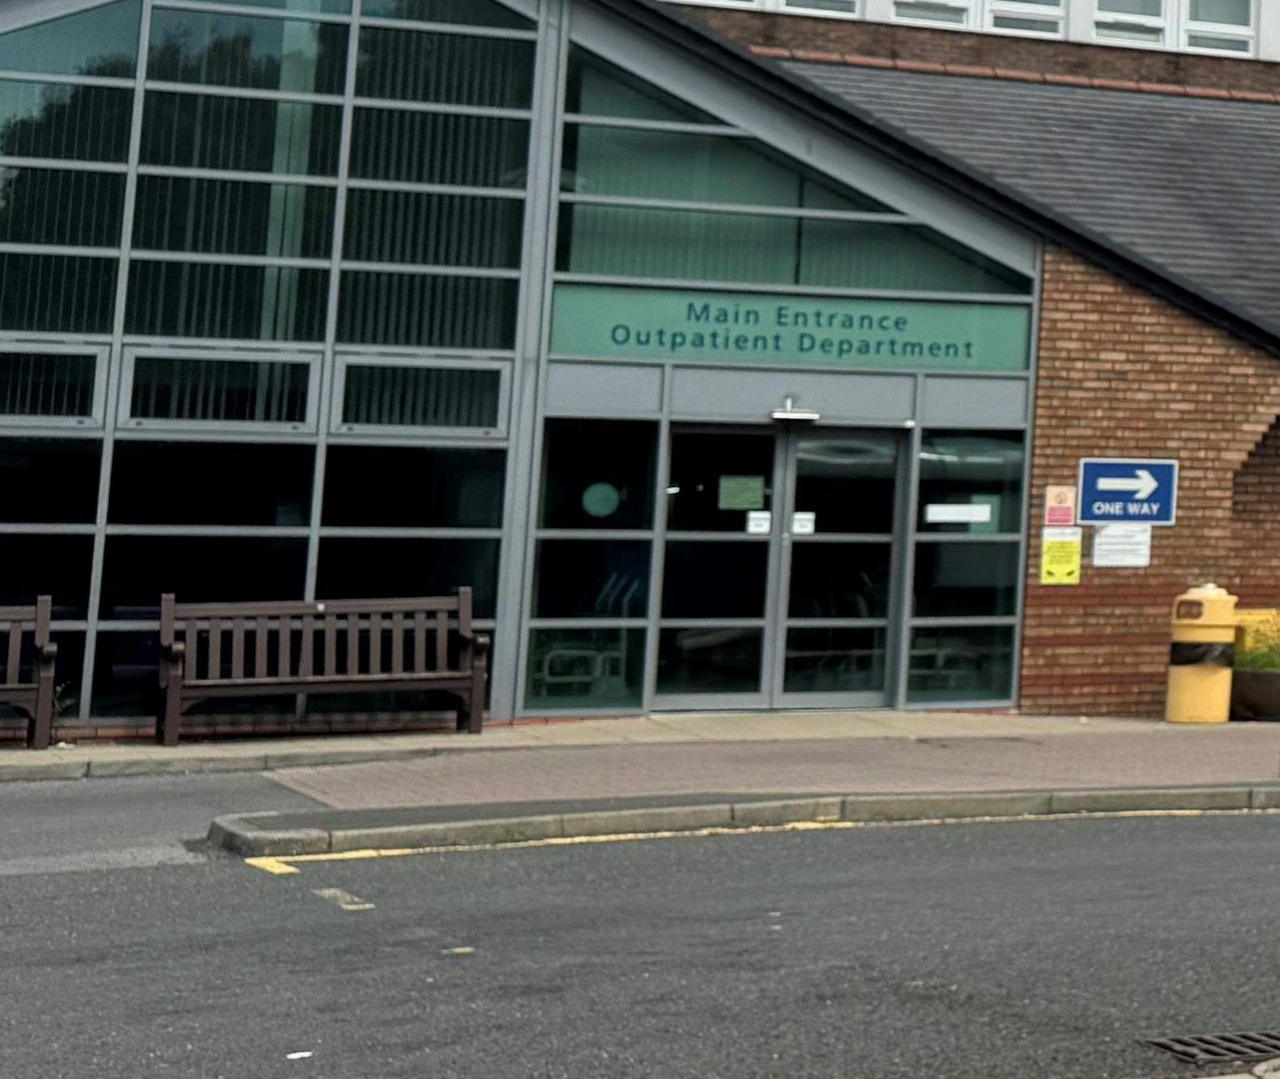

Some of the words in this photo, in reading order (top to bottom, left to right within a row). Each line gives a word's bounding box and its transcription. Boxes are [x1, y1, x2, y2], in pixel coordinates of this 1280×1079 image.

[686, 302, 760, 327] Main
[776, 305, 909, 332] Entrance
[610, 324, 783, 352] Outpatient
[798, 332, 974, 359] Department
[1092, 502, 1124, 516] ONE
[1126, 503, 1161, 515] WAY
